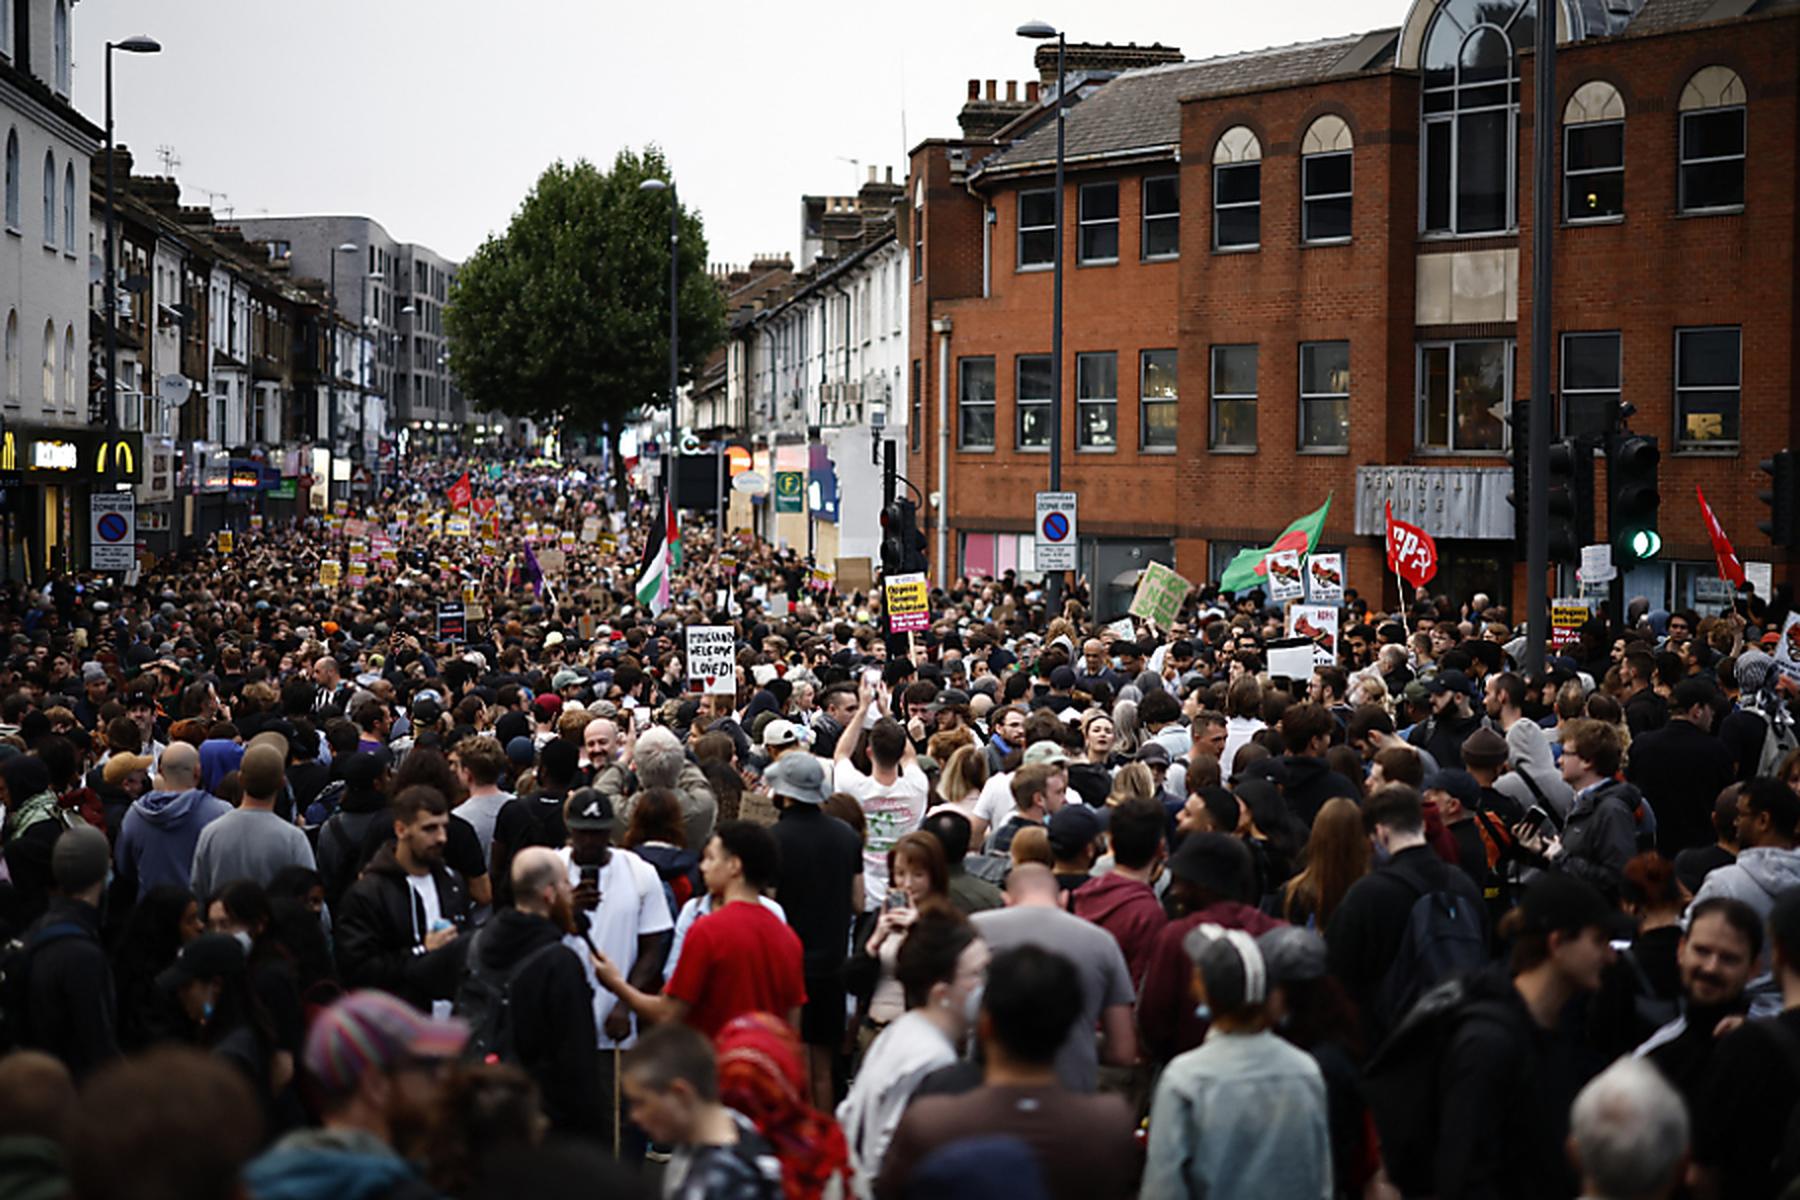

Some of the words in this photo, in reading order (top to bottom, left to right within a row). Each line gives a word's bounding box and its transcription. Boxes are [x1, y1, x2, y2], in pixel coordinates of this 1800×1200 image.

[888, 585, 918, 594] Oppose
[1146, 565, 1188, 600] FUCK
[1146, 586, 1179, 615] NAZI
[690, 645, 733, 657] WELCOME
